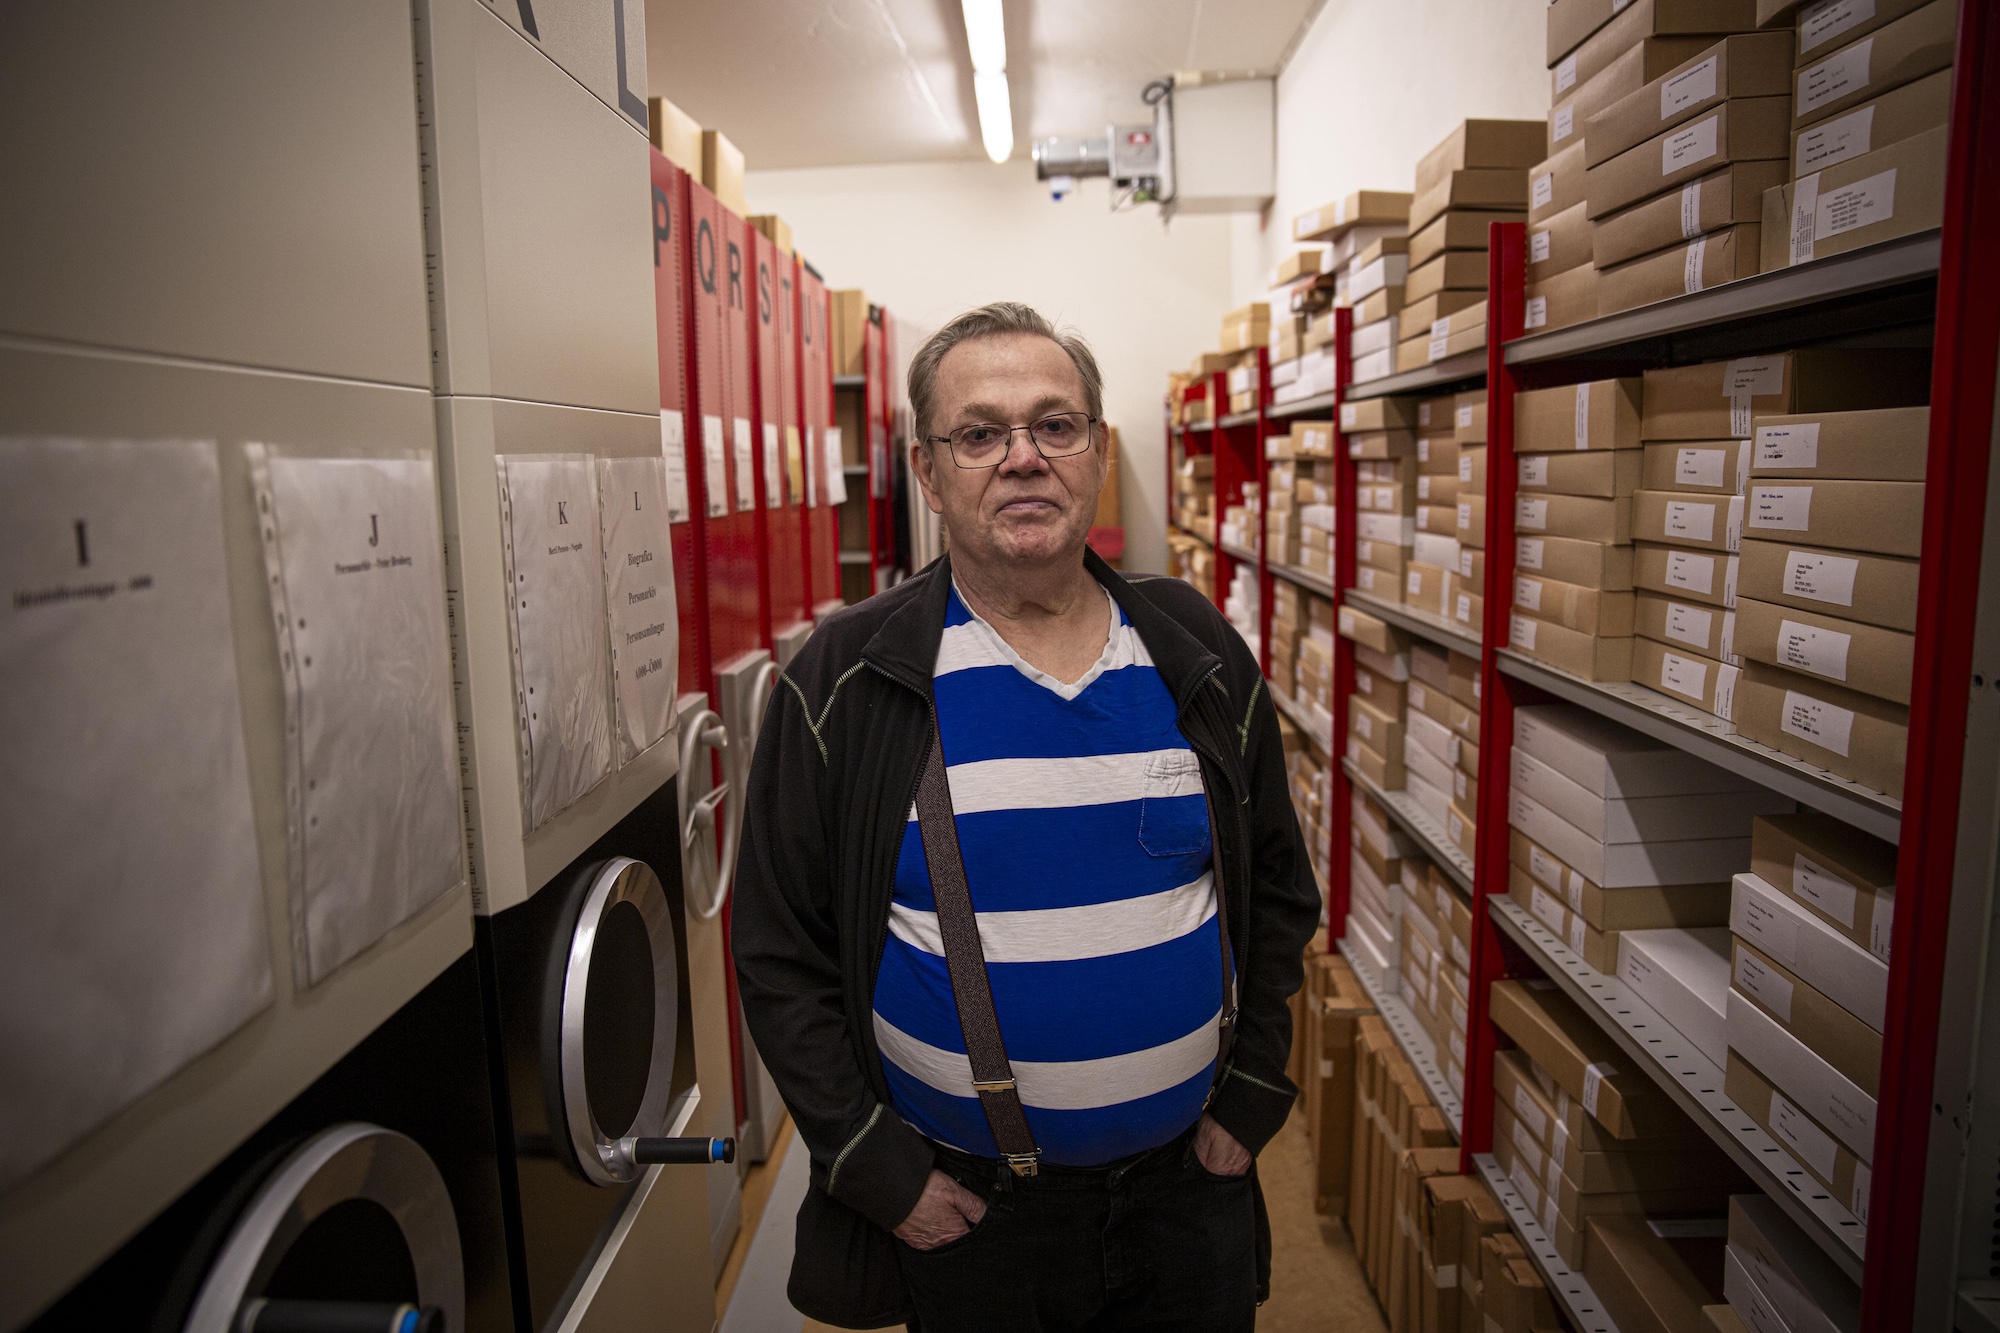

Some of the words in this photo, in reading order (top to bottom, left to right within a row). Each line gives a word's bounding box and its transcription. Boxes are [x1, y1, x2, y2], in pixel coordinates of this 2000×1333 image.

[652, 184, 670, 268] P
[697, 217, 717, 296] Q
[727, 241, 743, 312] R
[759, 261, 771, 326] S
[782, 277, 792, 333] T
[802, 292, 813, 346] U
[558, 501, 569, 525] K
[634, 491, 642, 511] L
[74, 518, 90, 568] I
[368, 513, 379, 548] J
[628, 550, 653, 567] Biografica
[628, 586, 657, 605] Personarkiv
[626, 622, 665, 645] Personsamlingar
